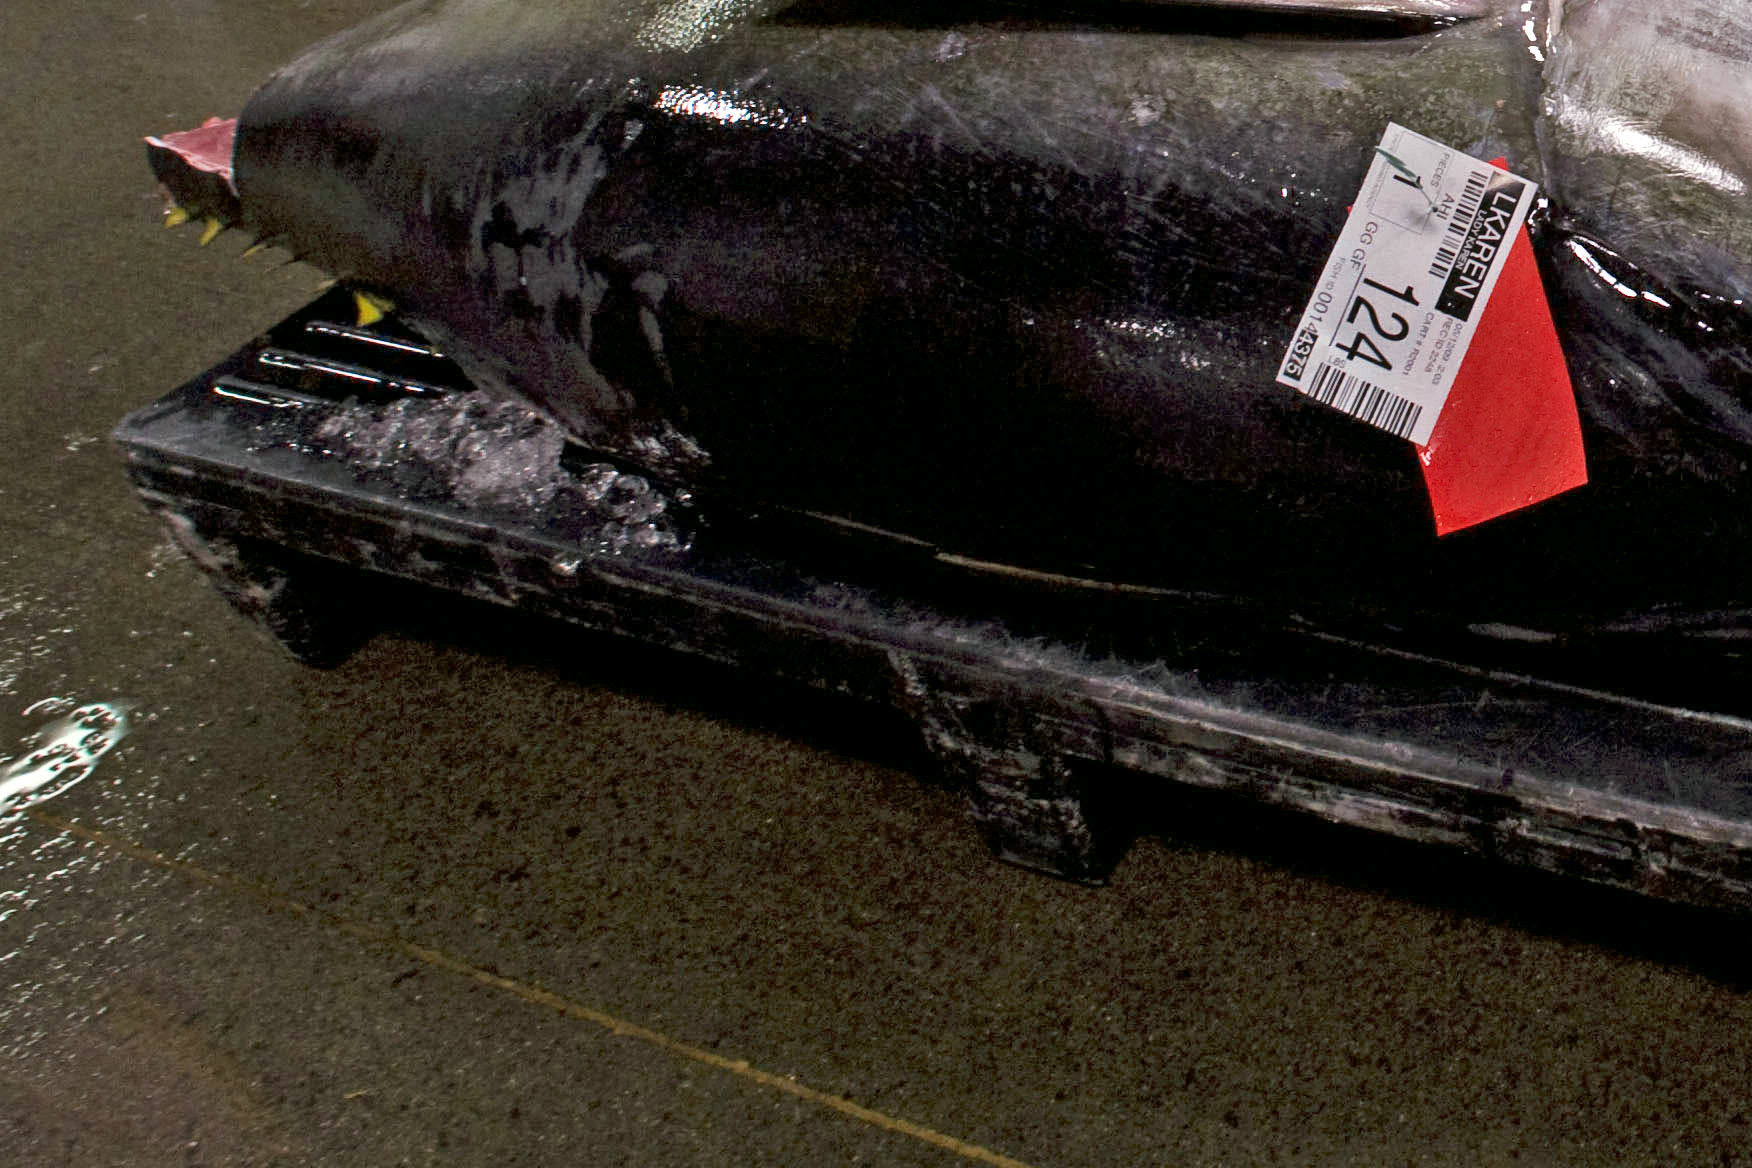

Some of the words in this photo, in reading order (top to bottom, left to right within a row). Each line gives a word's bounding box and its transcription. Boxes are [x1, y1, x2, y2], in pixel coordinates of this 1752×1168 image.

[1393, 174, 1422, 189] 1
[1435, 192, 1456, 220] AHI
[1470, 209, 1486, 235] LADY
[1453, 191, 1516, 300] LKAREN
[1455, 235, 1475, 270] KAREN
[1335, 276, 1420, 372] 124
